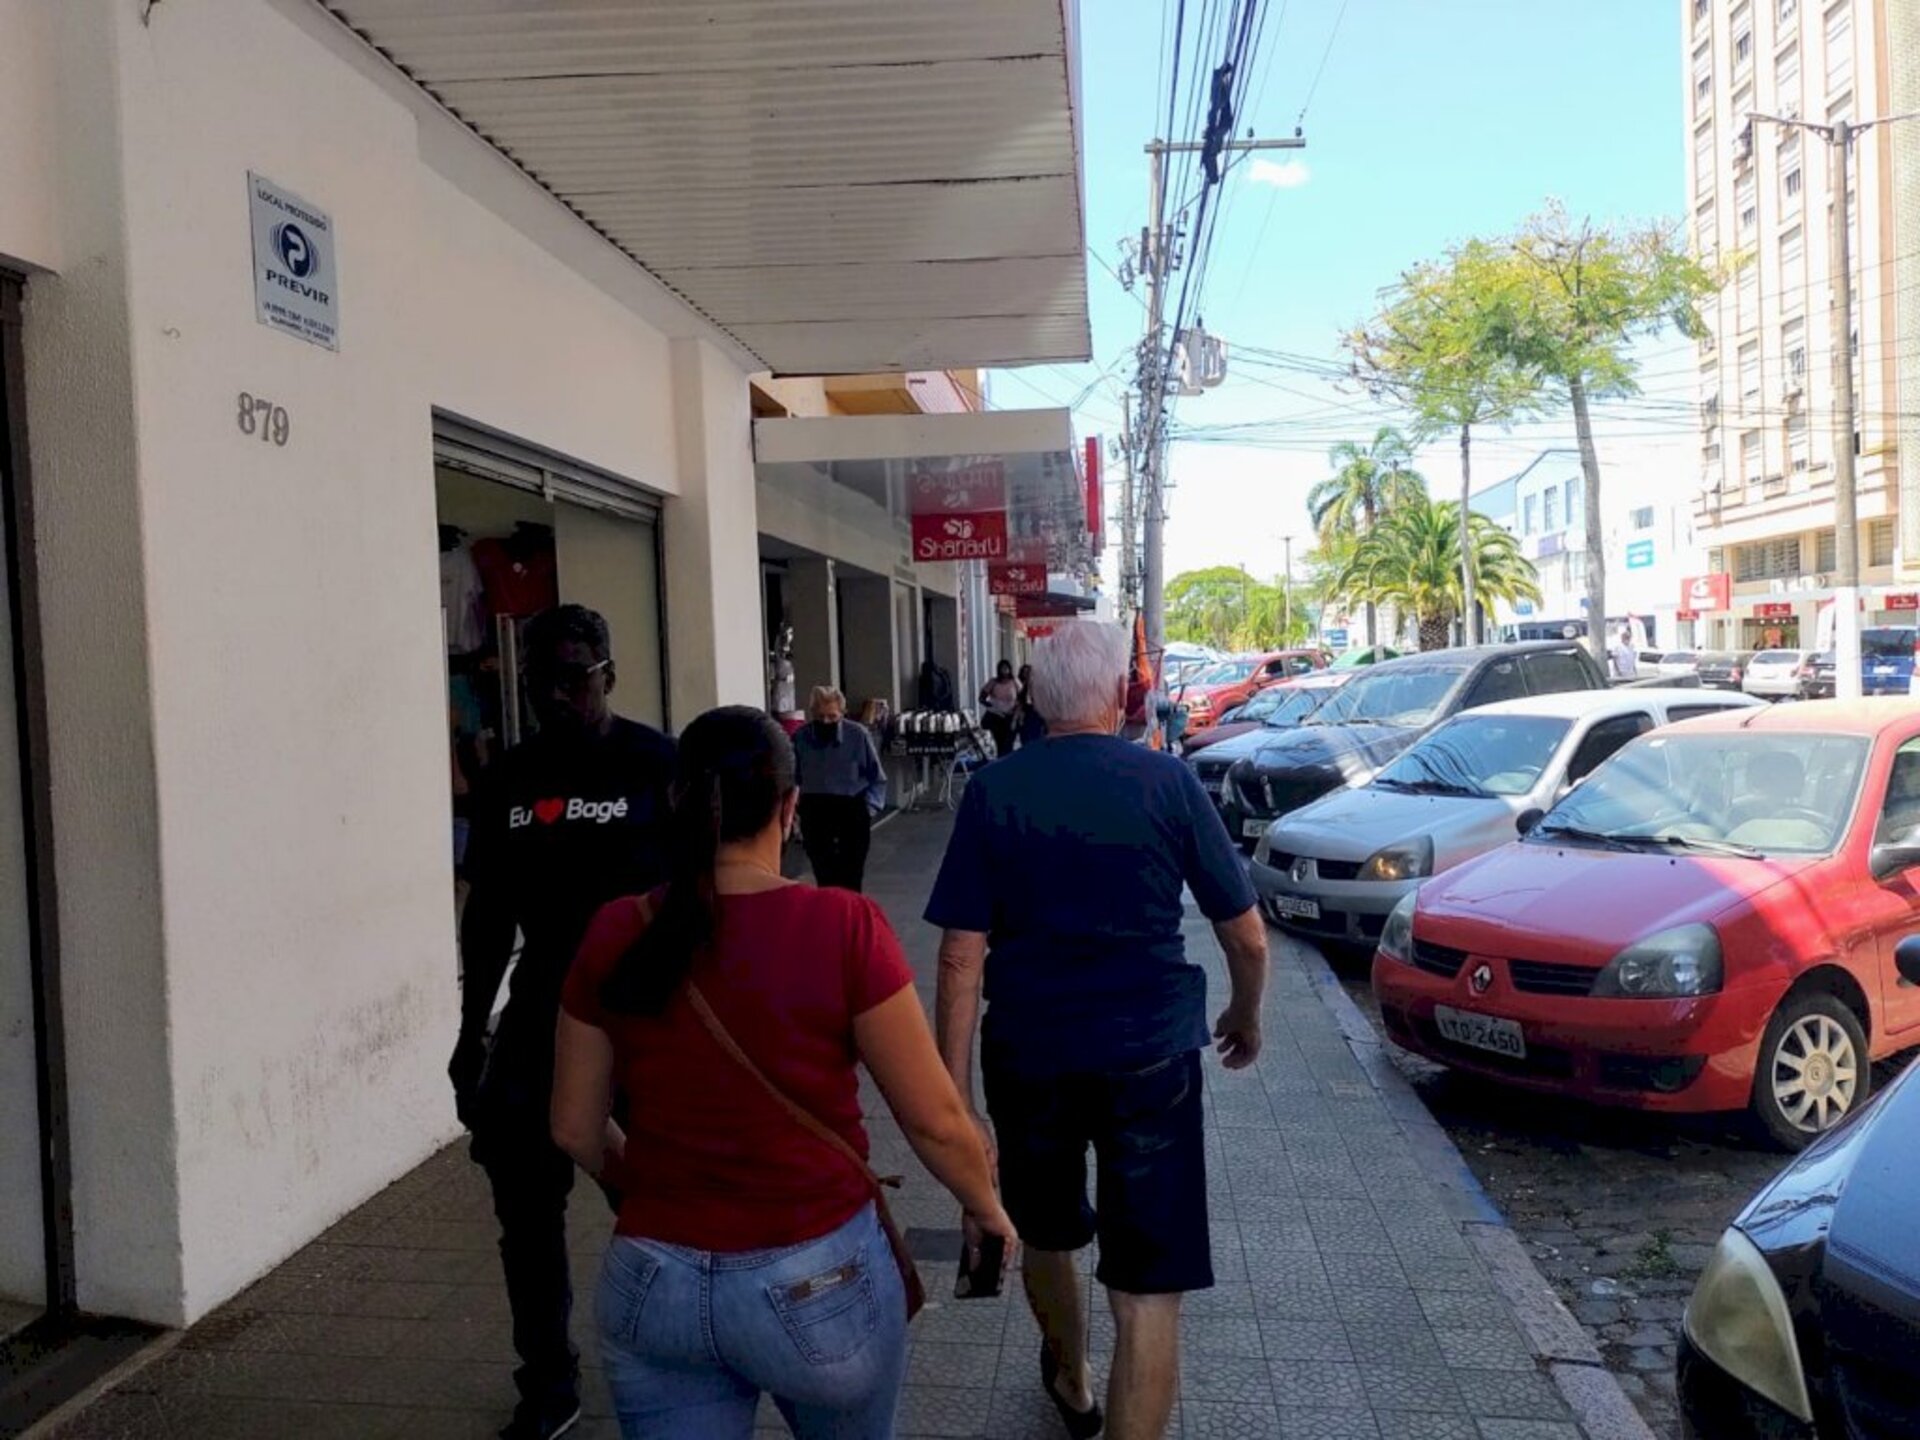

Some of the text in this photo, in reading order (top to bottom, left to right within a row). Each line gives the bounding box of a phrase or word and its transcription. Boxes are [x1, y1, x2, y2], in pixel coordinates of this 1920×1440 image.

[257, 187, 284, 211] LOCAL
[265, 269, 330, 306] PREVIR
[238, 391, 290, 447] 879
[509, 797, 629, 829] Eu Bagé
